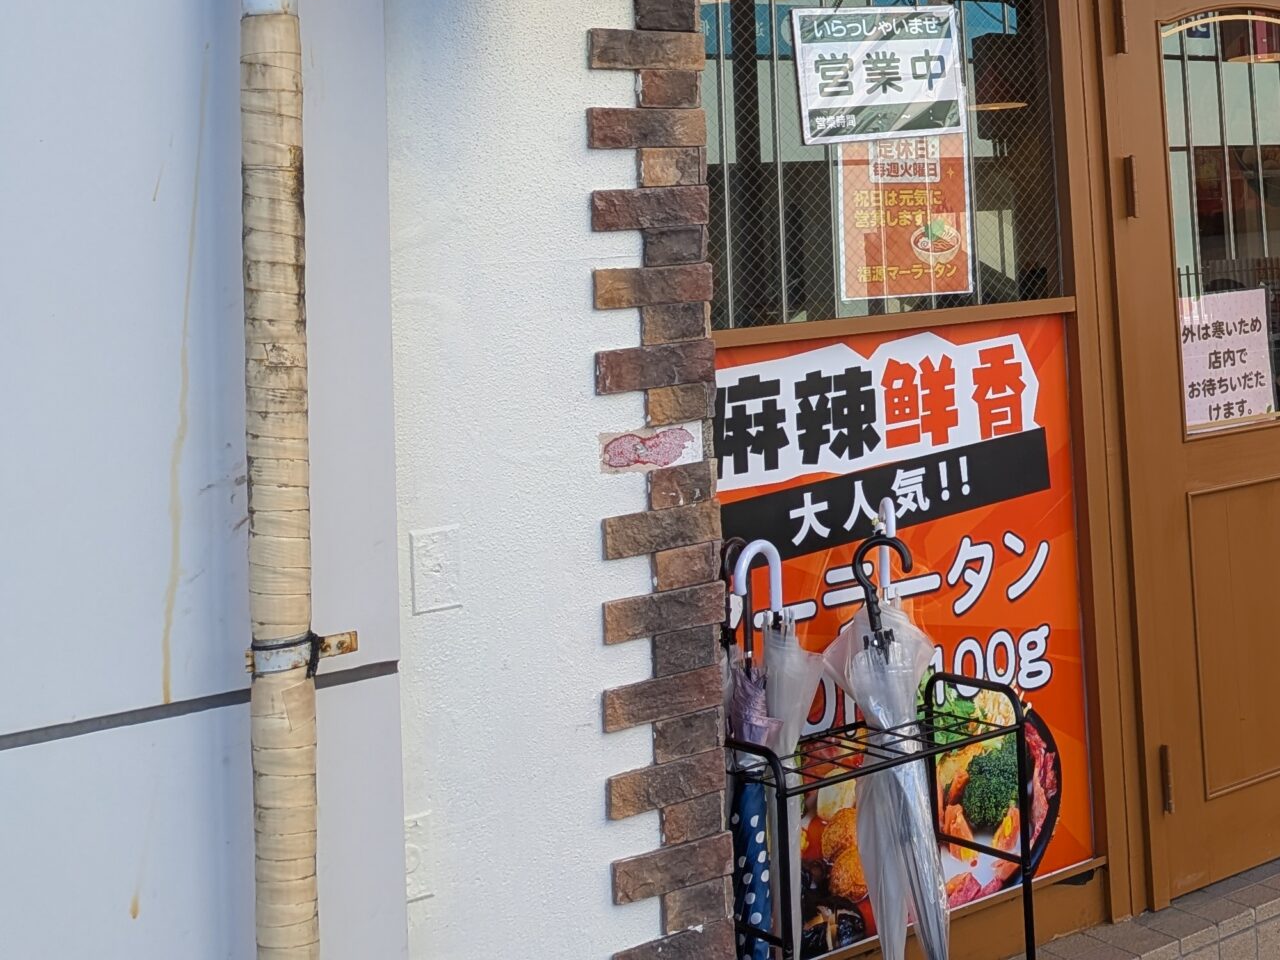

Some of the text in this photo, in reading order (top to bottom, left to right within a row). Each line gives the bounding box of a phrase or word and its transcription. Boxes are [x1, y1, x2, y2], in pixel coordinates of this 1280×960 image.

[814, 17, 939, 38] いらっしゃいませ
[814, 48, 947, 98] 営業中
[873, 161, 938, 178] 毎週火曜日
[854, 189, 942, 208] 祝日は元気に
[1182, 315, 1263, 344] 外は寒いため
[1208, 348, 1248, 370] 店内で
[1188, 370, 1267, 400] お待ちいだた
[716, 343, 1027, 480] 麻辣鮮香
[1208, 398, 1253, 422] けます。
[789, 455, 971, 547] 大人気!!
